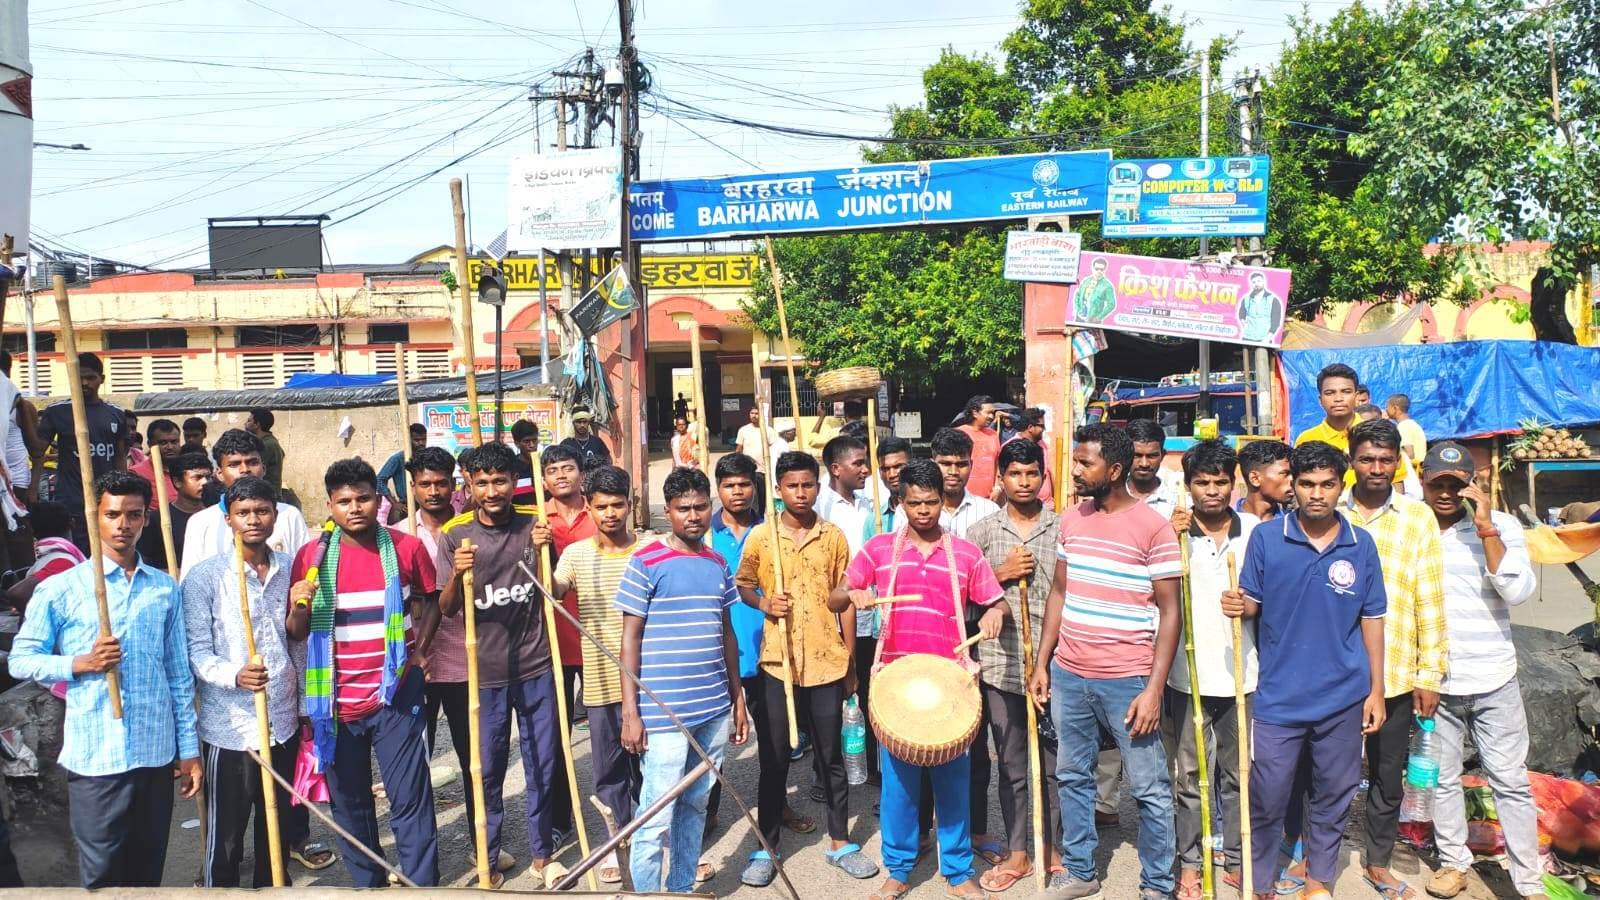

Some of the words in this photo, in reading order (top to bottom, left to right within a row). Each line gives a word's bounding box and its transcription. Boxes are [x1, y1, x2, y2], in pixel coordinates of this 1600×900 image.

[721, 176, 815, 199] बरहरवा
[836, 168, 921, 191] जंक्शन
[1142, 179, 1209, 194] COMPUTER
[630, 191, 668, 212] गतम्
[697, 200, 820, 227] BARHARWA
[837, 190, 952, 218] JUNCTION
[1001, 200, 1045, 212] EASTERN
[1046, 197, 1089, 209] RAILWAY
[632, 212, 675, 231] COME
[73, 442, 115, 461] eep
[474, 582, 535, 610] Jeep
